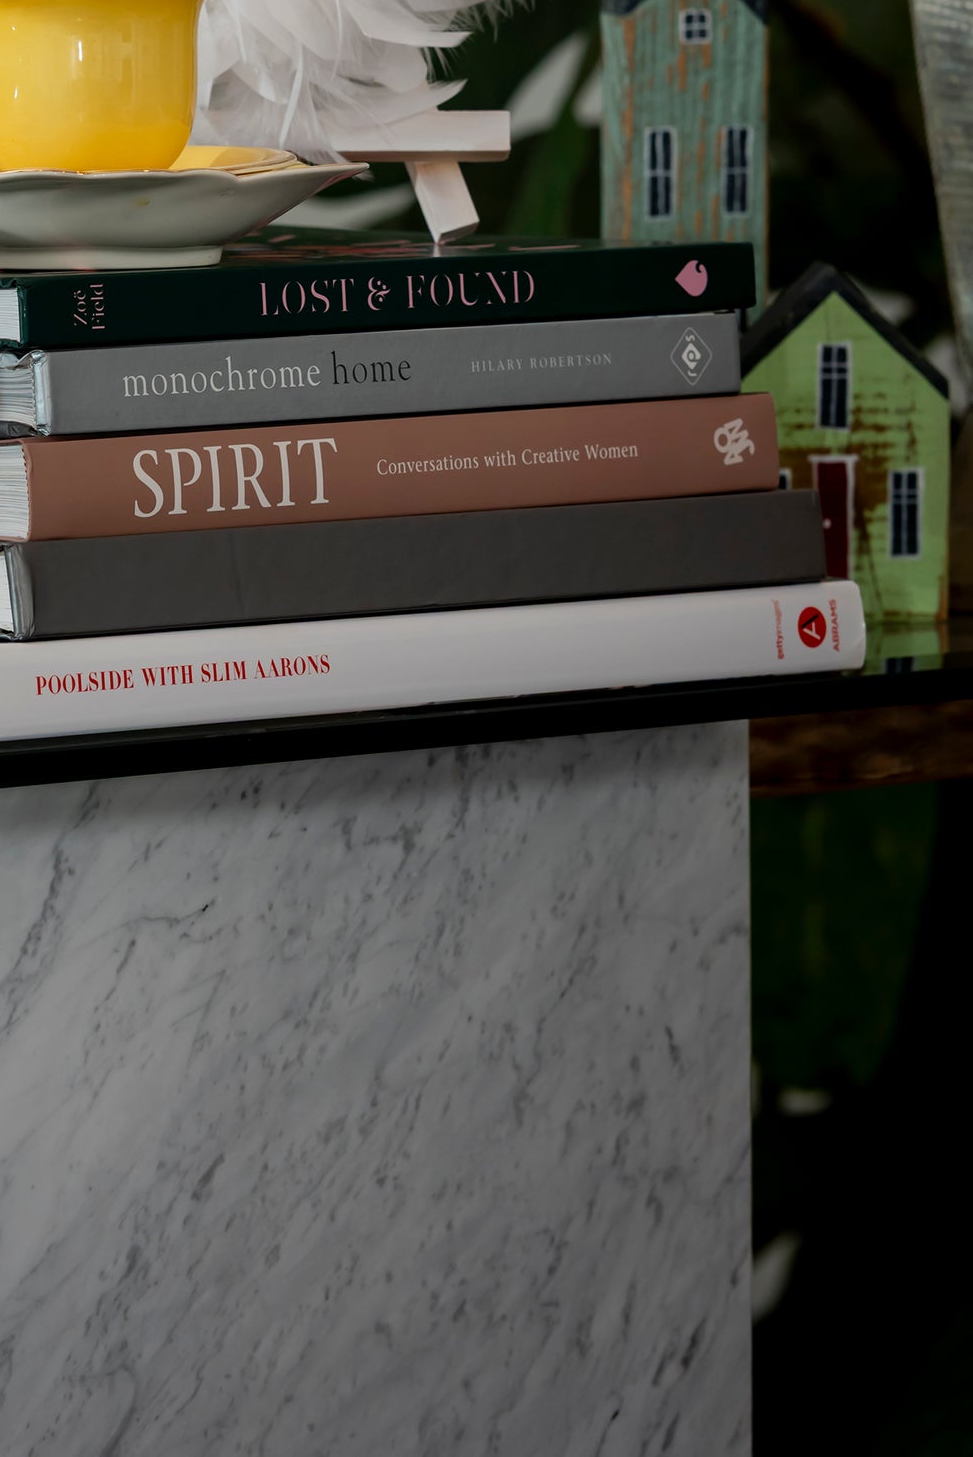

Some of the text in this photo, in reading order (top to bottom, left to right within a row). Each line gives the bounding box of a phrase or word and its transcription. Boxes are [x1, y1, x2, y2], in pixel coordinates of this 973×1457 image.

[73, 290, 88, 326] Zoë
[90, 283, 105, 329] Field
[260, 270, 535, 315] LOST & FOUND
[122, 350, 412, 397] monochrome home
[471, 352, 612, 373] HILARY ROBERTSON
[132, 437, 338, 519] SPIRIT
[376, 442, 639, 476] Conversations with Creative Women
[828, 598, 841, 653] ABRAMS
[35, 653, 331, 696] POOLSIDE WITH SLIM AARONS
